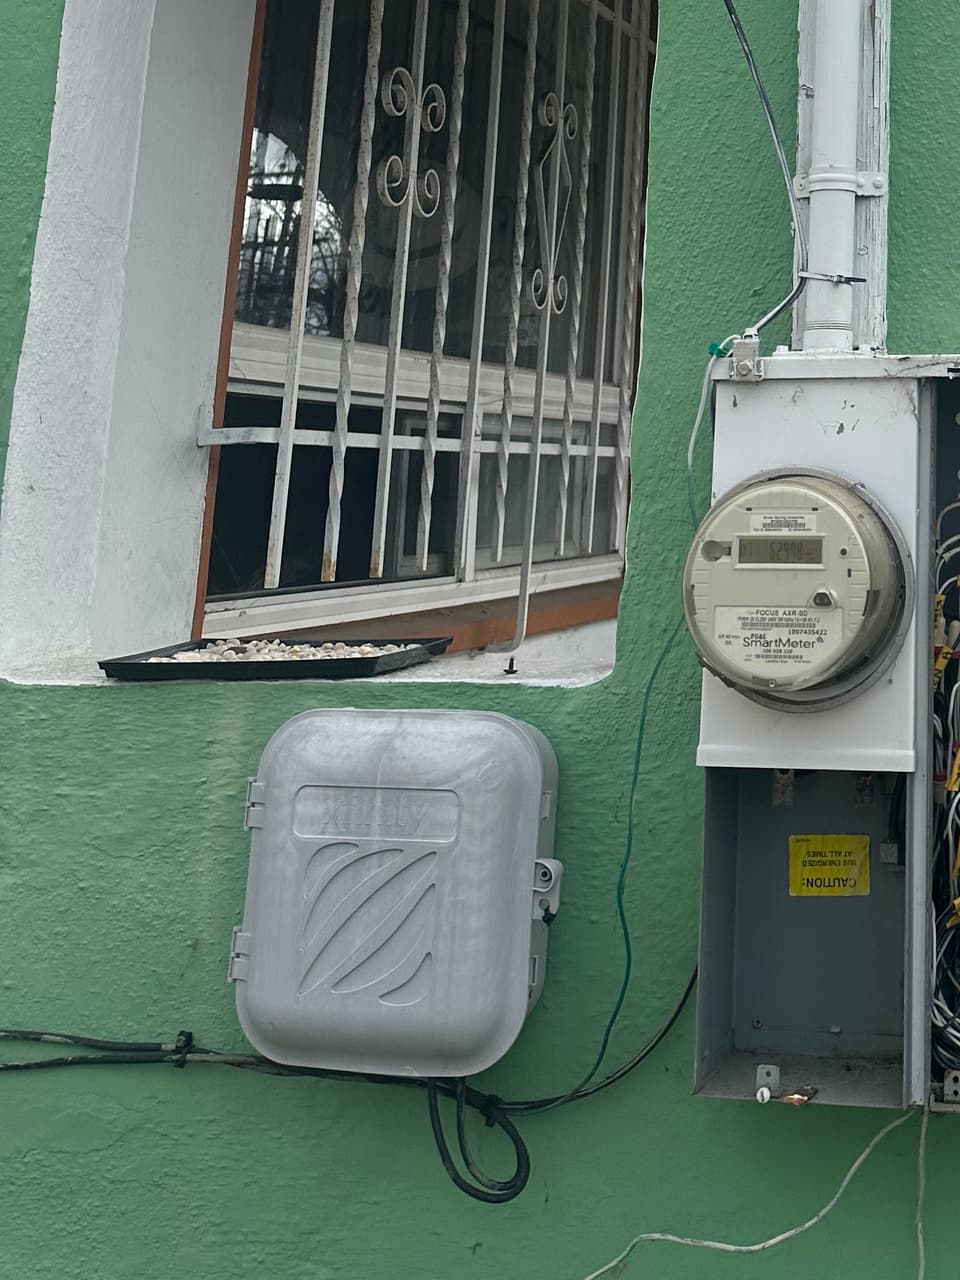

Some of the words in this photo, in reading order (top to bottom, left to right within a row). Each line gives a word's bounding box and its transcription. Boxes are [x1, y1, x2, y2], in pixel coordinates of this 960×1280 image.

[755, 609, 779, 617] FOCUS
[742, 636, 816, 648] SmartMeter
[802, 877, 856, 888] CAUTION:
